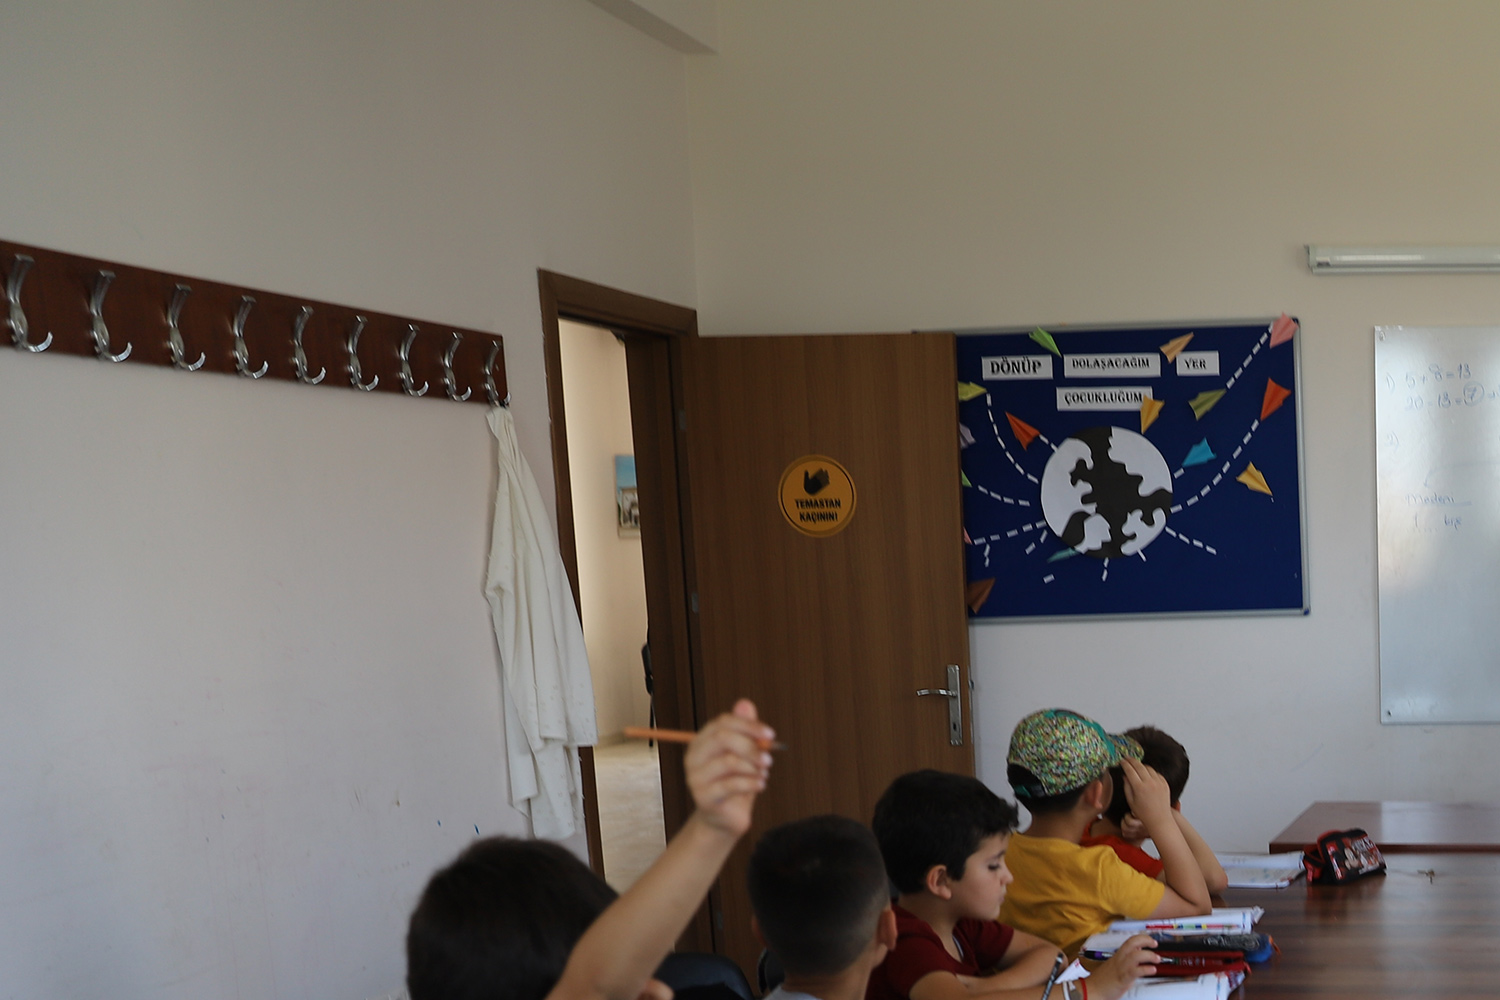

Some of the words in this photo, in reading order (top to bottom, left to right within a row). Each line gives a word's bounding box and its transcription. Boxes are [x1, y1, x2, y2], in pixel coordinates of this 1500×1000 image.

[990, 356, 1042, 376] DÖNÜP
[1072, 356, 1150, 372] DOLAŞACAĞIM
[1184, 357, 1208, 371] YER
[1063, 389, 1145, 407] ÇOCUKLUĞUM
[795, 498, 842, 510] TEMASTAN
